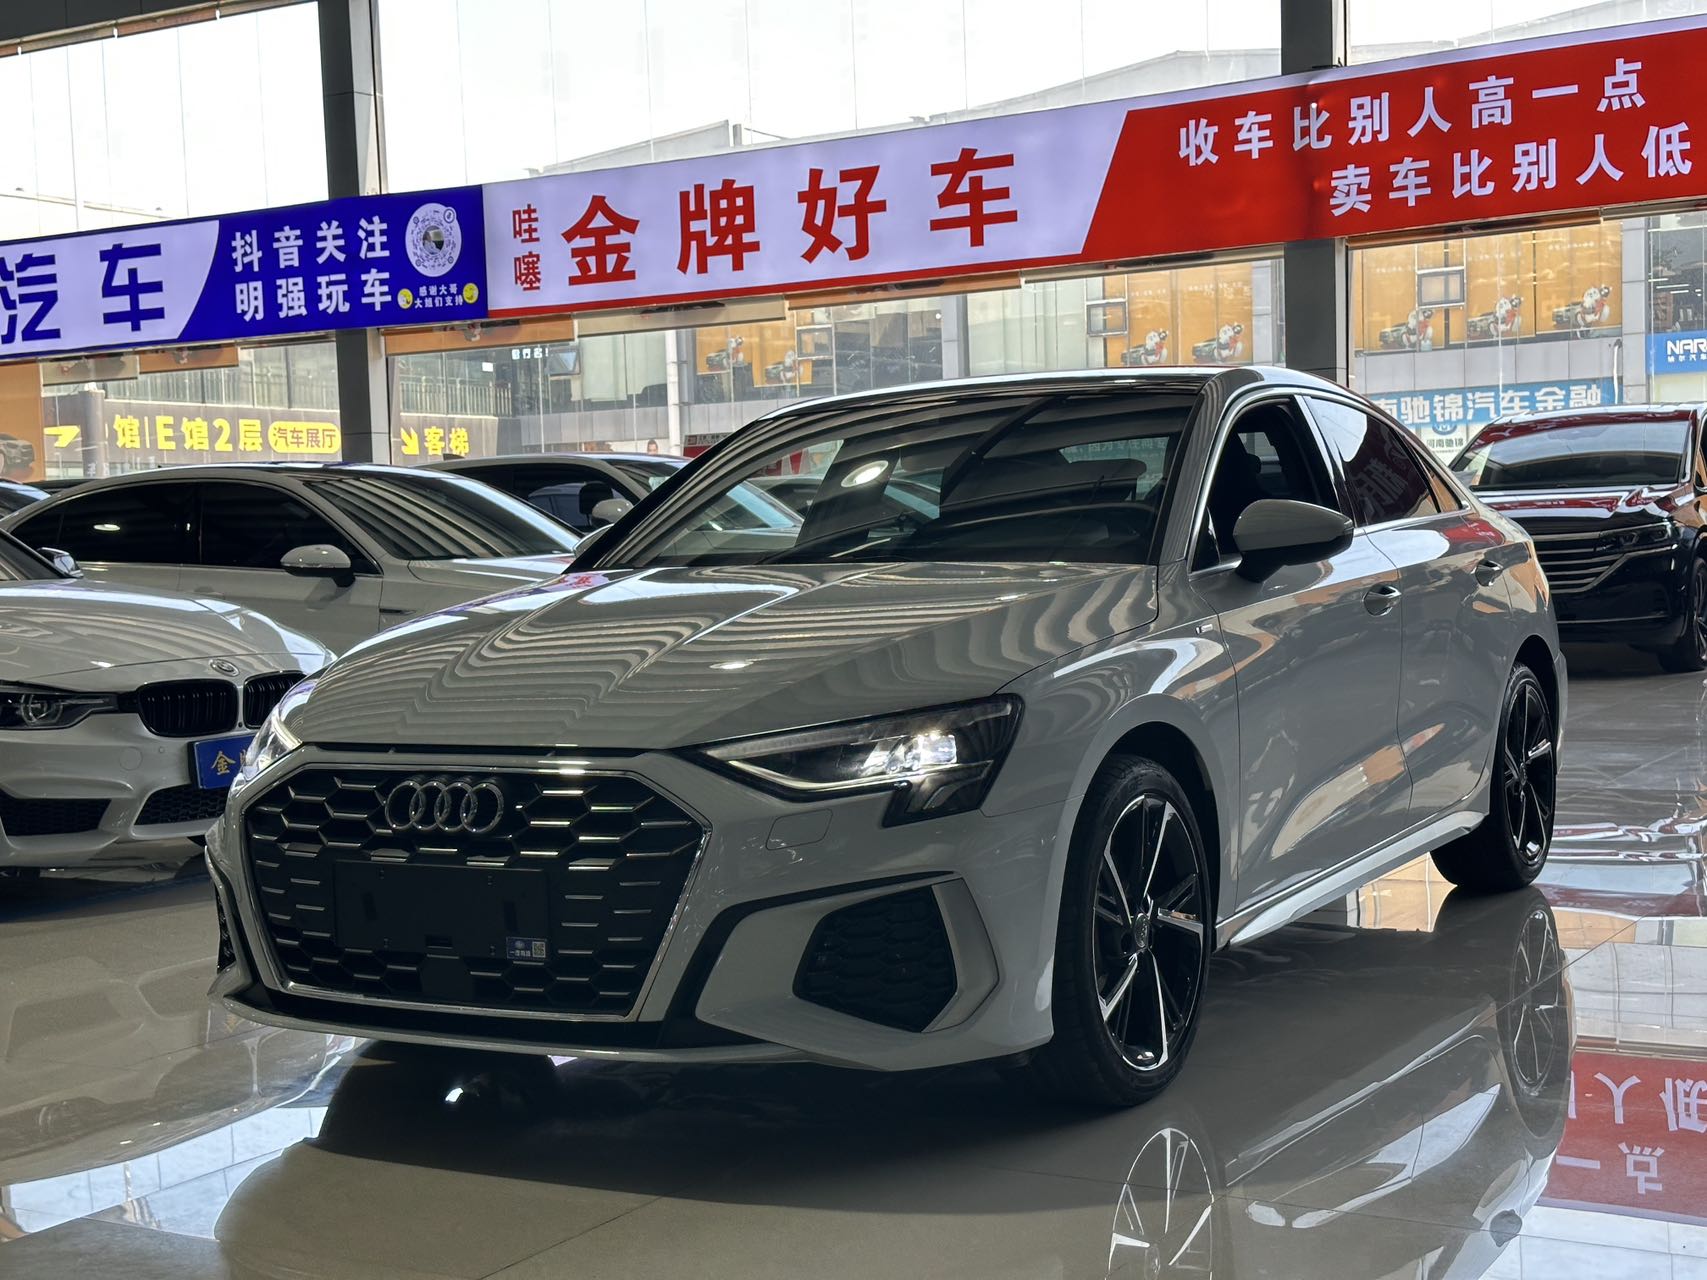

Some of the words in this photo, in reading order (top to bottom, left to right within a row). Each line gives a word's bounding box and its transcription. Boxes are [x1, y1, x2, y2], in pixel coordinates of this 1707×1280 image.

[1178, 57, 1646, 167] 收车比别人高一点
[1329, 121, 1693, 217] 卖车比别人低
[231, 215, 391, 272] 抖音关注
[562, 148, 1019, 286] 金牌好车
[512, 203, 542, 292] 哇噻
[0, 242, 165, 345] 汽车
[235, 268, 392, 322] 明强玩车
[414, 294, 464, 309] 大姐们支持
[418, 283, 459, 297] 感谢大哥
[272, 426, 338, 449] 汽车展厅
[424, 426, 471, 456] 客梯
